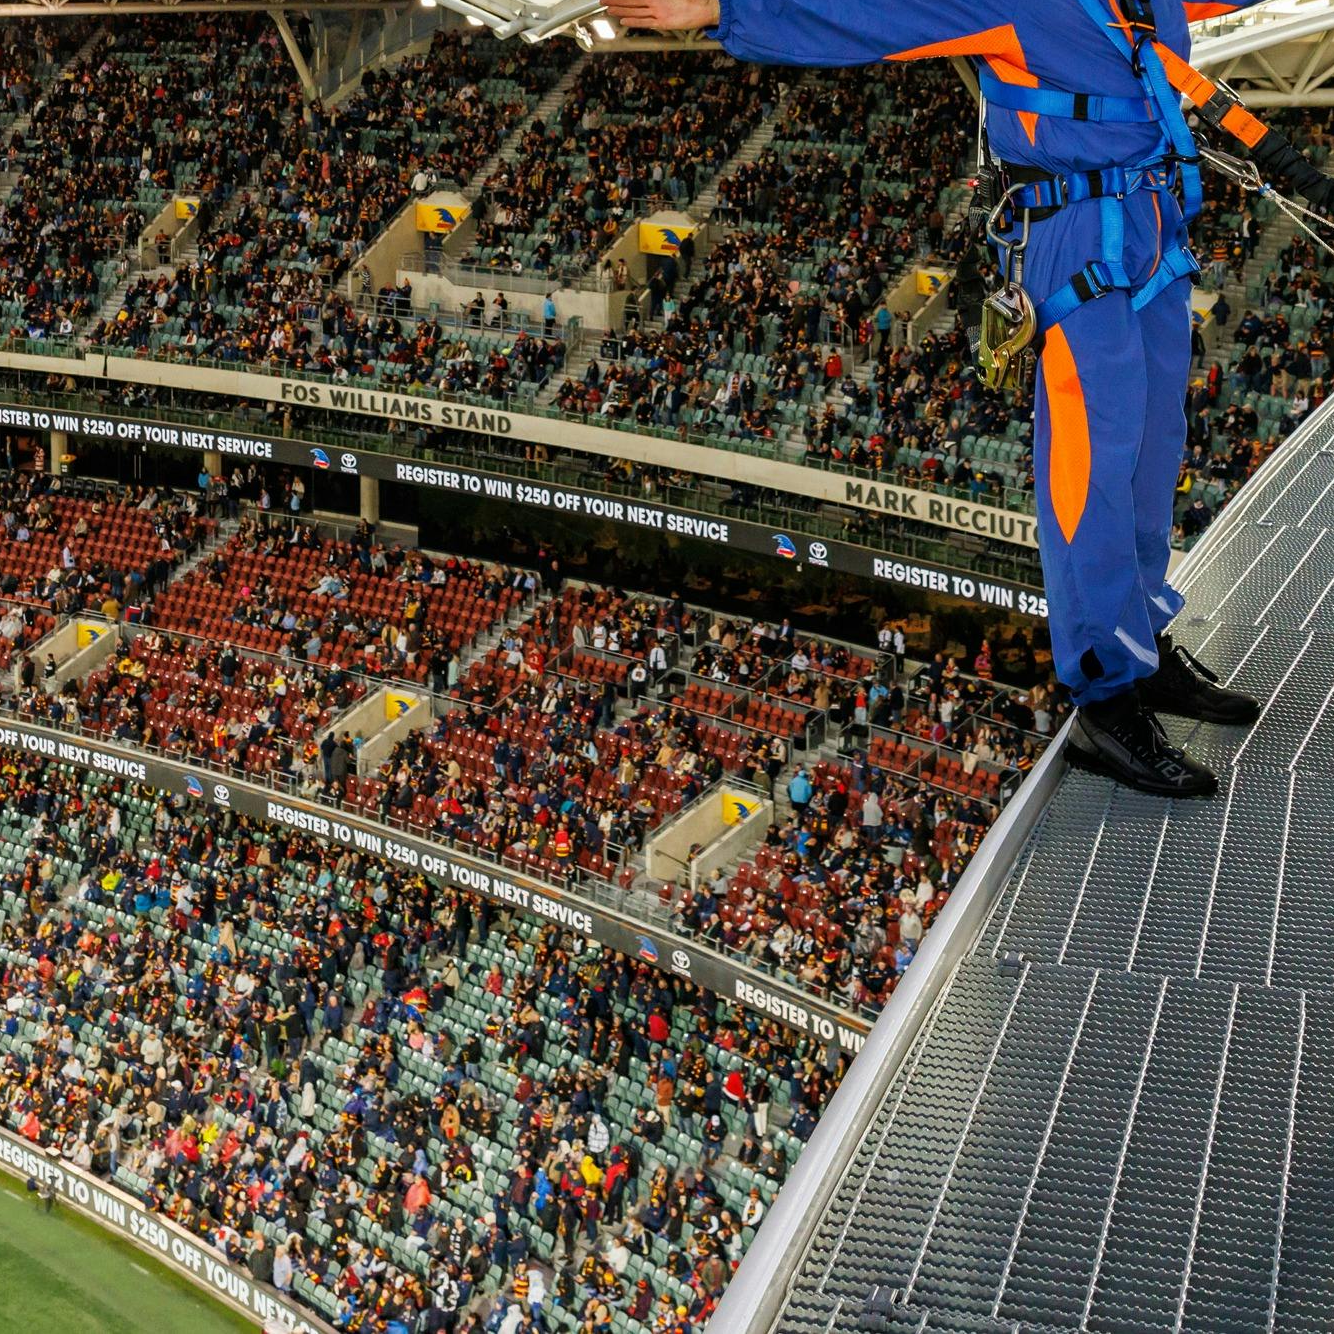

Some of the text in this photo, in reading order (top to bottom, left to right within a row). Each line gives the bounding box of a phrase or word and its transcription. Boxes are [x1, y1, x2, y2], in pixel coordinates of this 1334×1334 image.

[281, 383, 511, 434] FOS WILLIAMS STAND
[32, 412, 50, 429] TO
[52, 414, 79, 432] WIN
[82, 417, 114, 436] $250
[117, 422, 142, 440] OFF
[143, 425, 179, 445] YOUR
[181, 431, 215, 450] NEXT
[217, 436, 272, 458] SERVICE
[396, 463, 728, 542] REGISTER TO WIN $250 OFF YOUR NEXT SERVICE
[845, 481, 917, 516] MARK
[873, 558, 949, 593] REGISTER
[951, 576, 976, 598] TO
[978, 582, 1013, 608] WIN
[20, 734, 56, 756] YOUR
[58, 742, 91, 765] NEXT
[92, 752, 146, 780] SERVICE
[267, 801, 593, 934] REGISTER TO WIN $250 OFF YOUR NEXT SERVICE
[735, 979, 808, 1029] REGISTER
[811, 1014, 835, 1039] TO
[67, 1178, 90, 1206] TO
[92, 1193, 126, 1228] WIN
[130, 1211, 170, 1252] $250
[172, 1243, 203, 1272] OFF
[205, 1264, 251, 1307] YOUR
